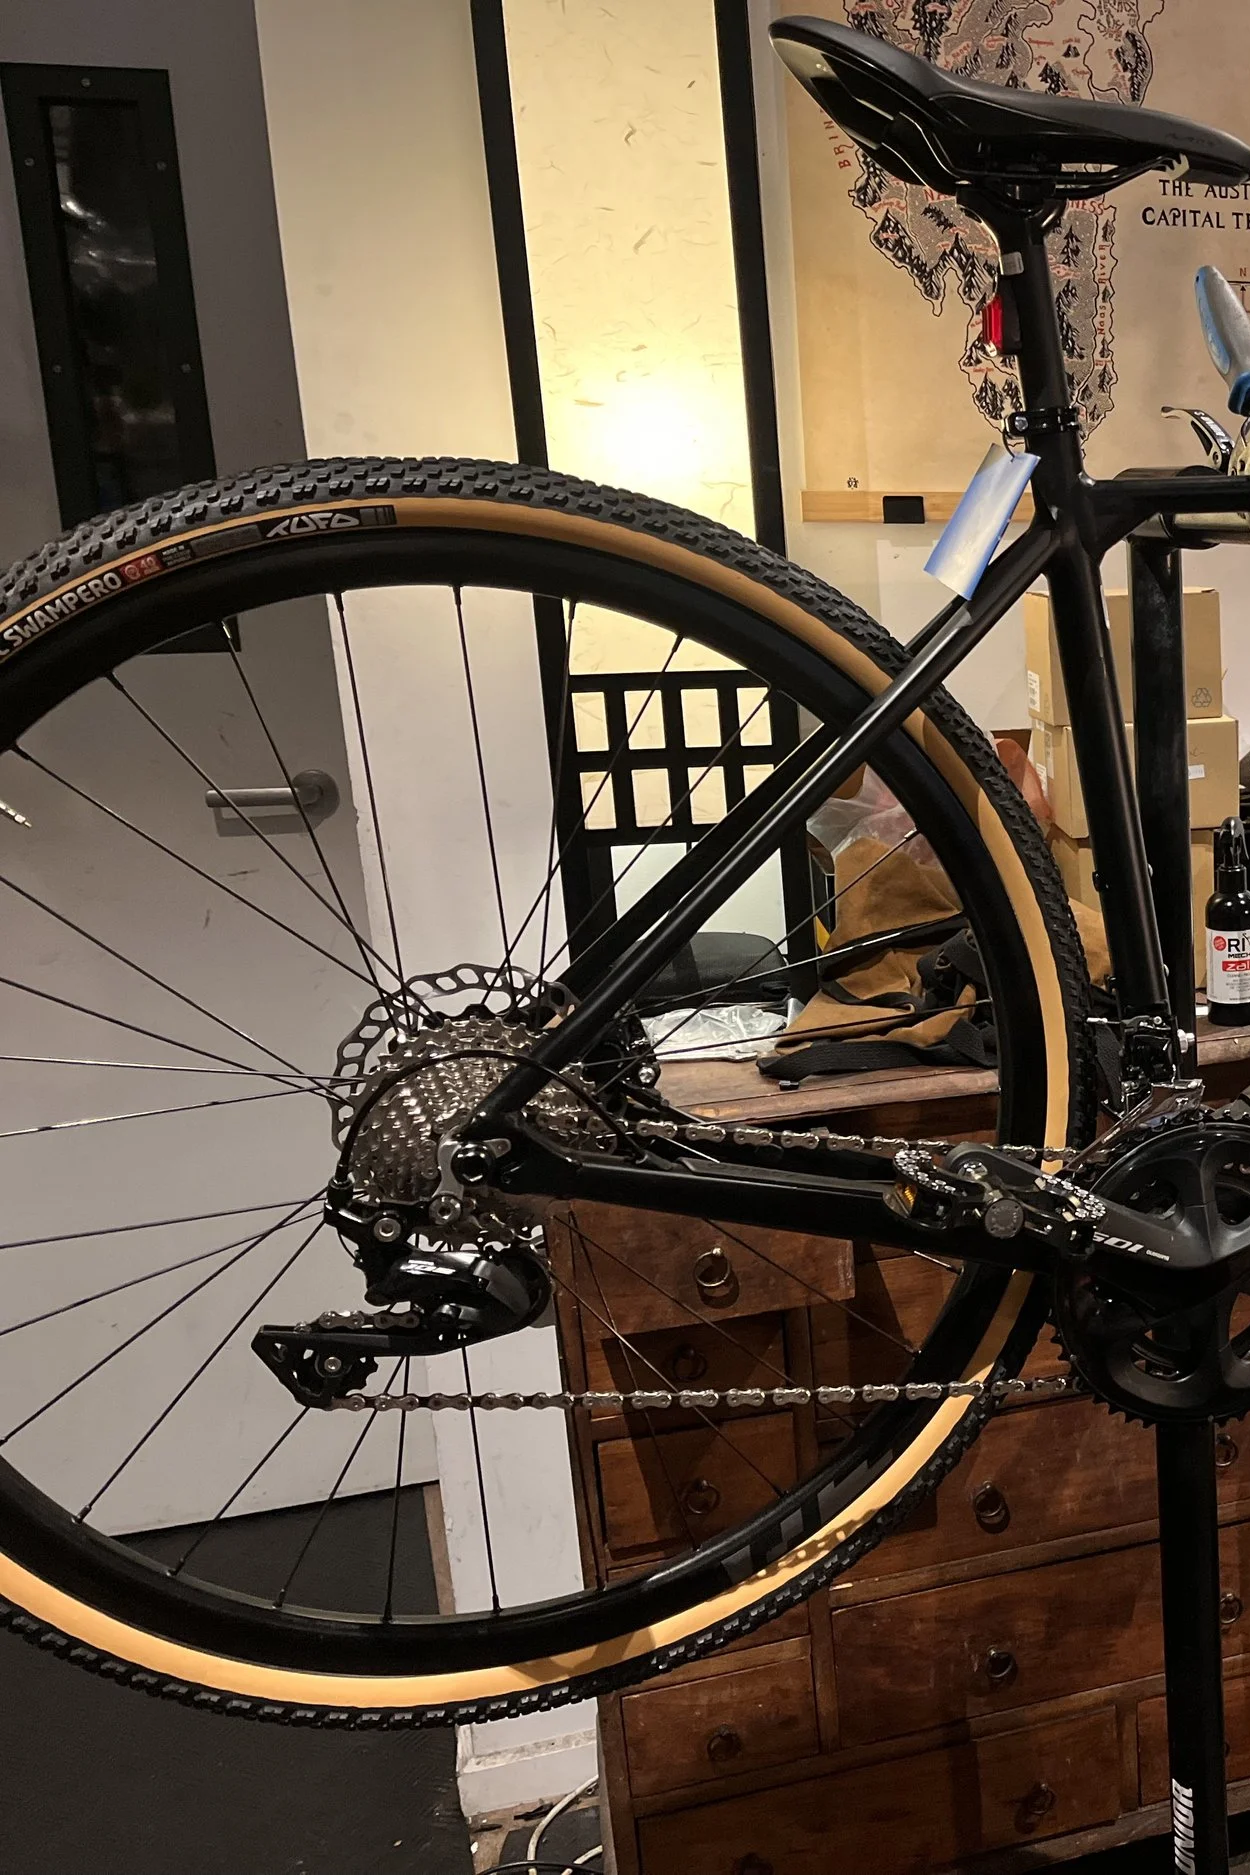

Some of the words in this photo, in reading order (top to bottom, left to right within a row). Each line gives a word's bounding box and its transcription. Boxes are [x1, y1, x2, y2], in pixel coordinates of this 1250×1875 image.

[1159, 179, 1194, 198] THE
[1142, 206, 1226, 229] CAPITAL
[1239, 267, 1247, 277] N
[265, 512, 361, 539] TUFO
[3, 572, 122, 648] SWAMPERO
